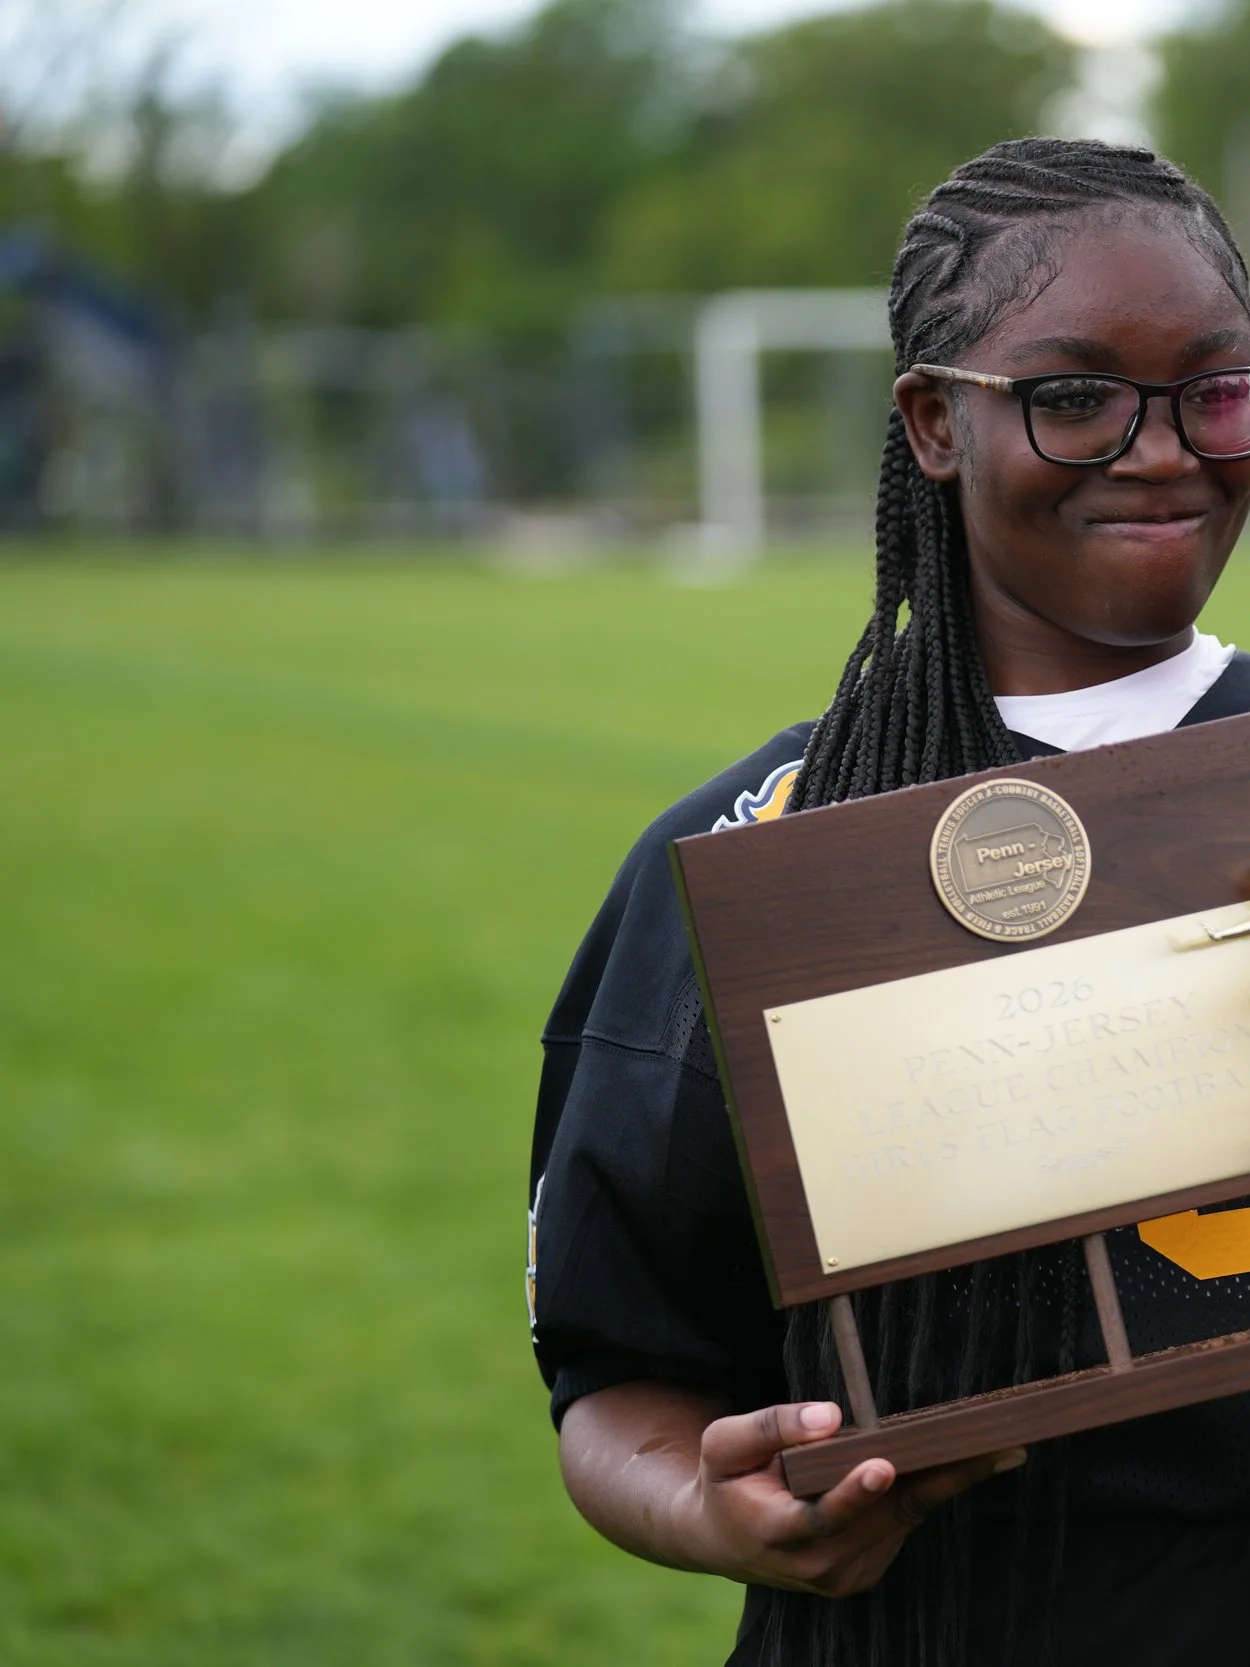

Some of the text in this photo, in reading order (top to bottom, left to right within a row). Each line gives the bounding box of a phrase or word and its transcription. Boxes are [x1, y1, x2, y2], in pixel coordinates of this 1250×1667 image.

[952, 794, 985, 819] SOCCER
[986, 785, 1039, 799] X-COUNTRY
[1042, 793, 1081, 841] BASKETBALL
[939, 820, 956, 854] TENNIS
[976, 842, 1025, 863] Penn
[1014, 853, 1073, 878] Jersey
[1070, 845, 1086, 891] SOFTBALL
[938, 858, 966, 913] VOLLEYBALL
[969, 880, 1046, 905] Athletic League
[966, 912, 993, 931] FIELD
[1038, 893, 1075, 929] BASEBALL
[1004, 924, 1036, 935] TRACK
[993, 974, 1094, 1021] 2026
[903, 991, 1197, 1084] PENN-JERSEY
[857, 1073, 1030, 1137] LEAGUE
[841, 1133, 960, 1182] GIRLS
[976, 1105, 1078, 1152] FLAG
